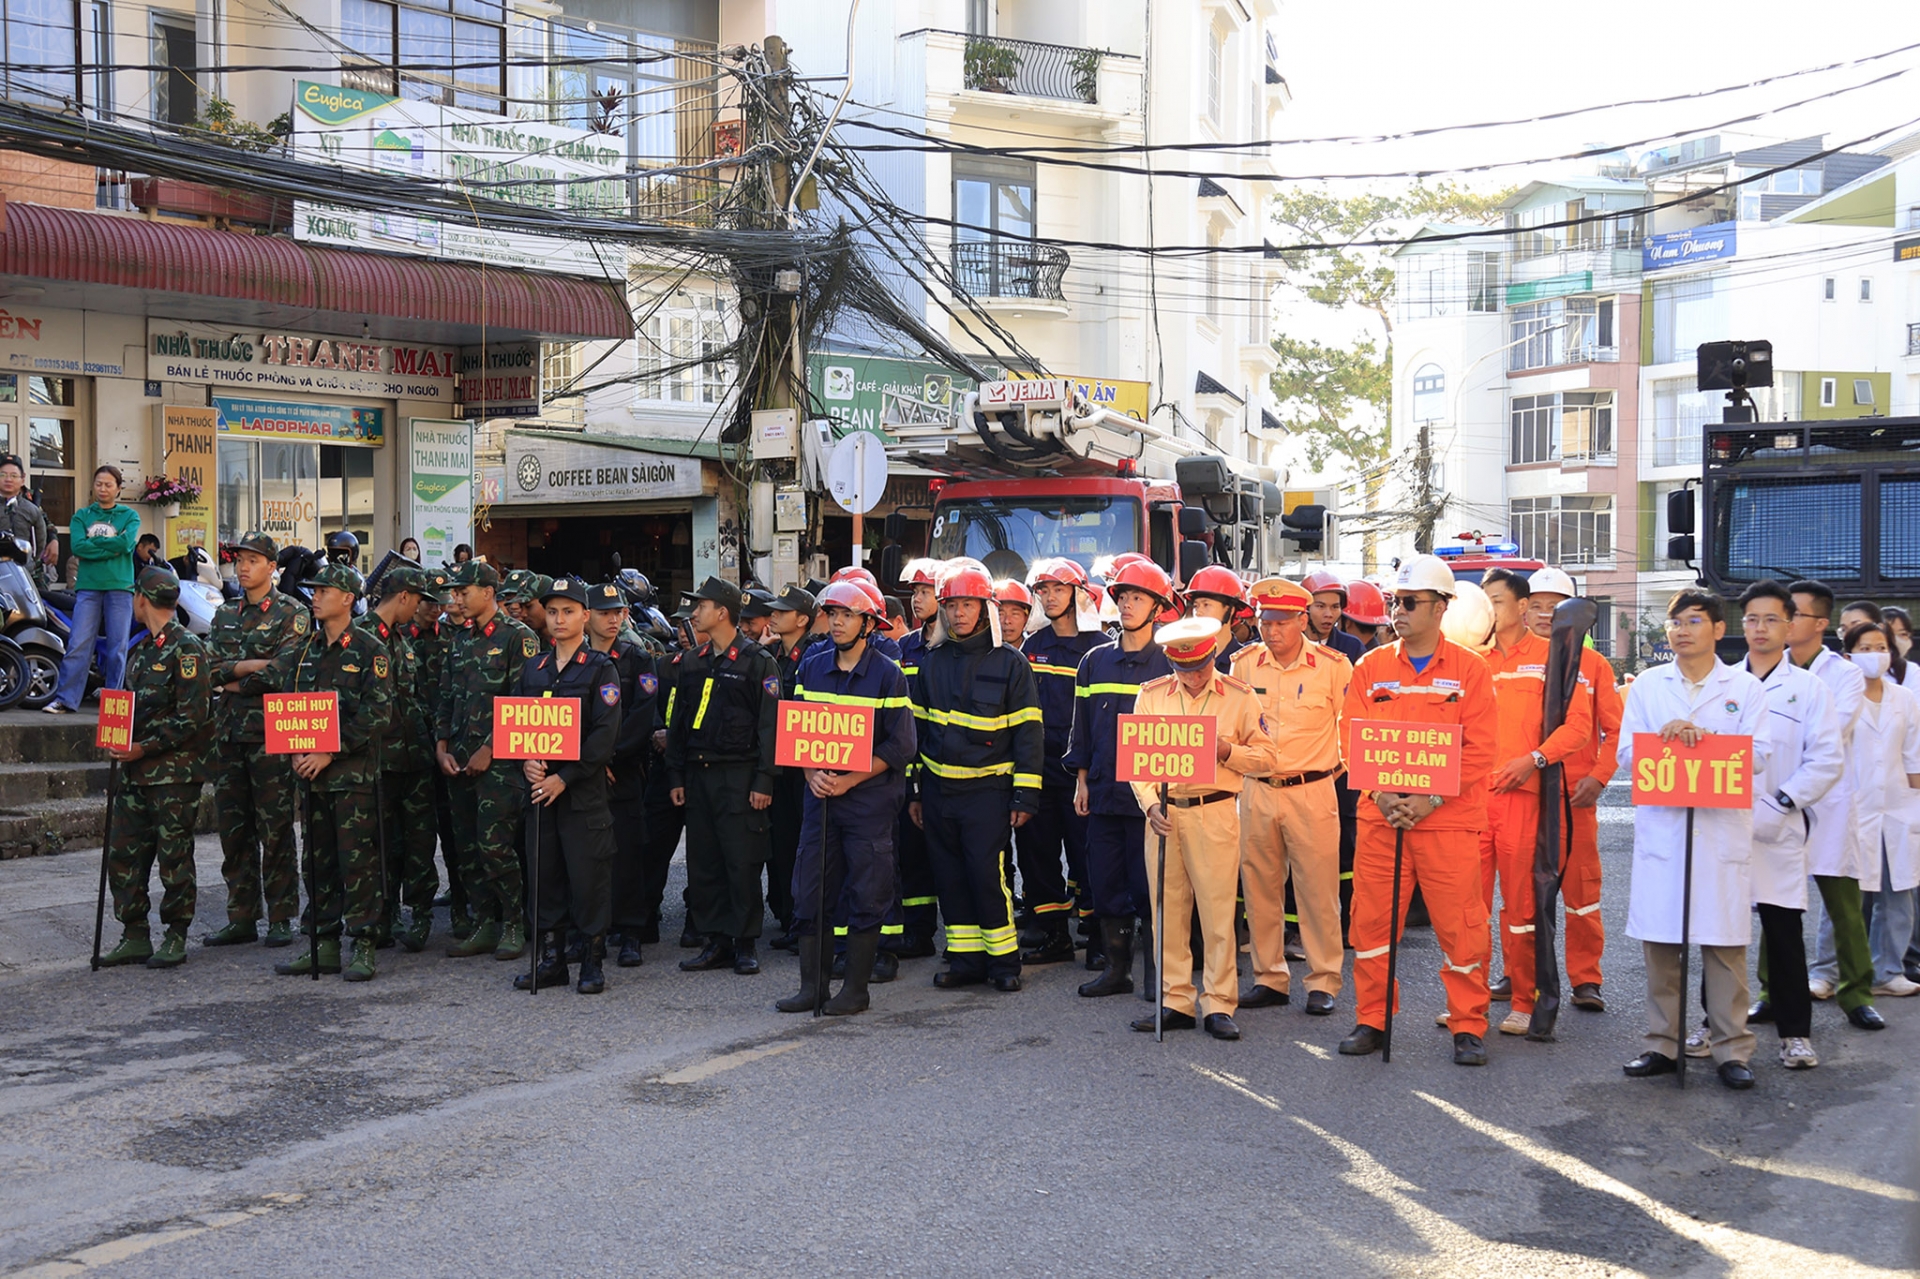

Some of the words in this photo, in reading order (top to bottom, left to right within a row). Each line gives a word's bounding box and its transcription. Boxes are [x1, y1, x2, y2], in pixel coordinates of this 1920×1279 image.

[304, 86, 363, 111] Eugica
[157, 332, 192, 358] NHÀ
[198, 333, 253, 362] THUỐC
[262, 335, 383, 373] THANH
[392, 347, 454, 378] MAI
[167, 364, 191, 377] BÁN
[213, 367, 253, 382] THUỐC
[407, 383, 439, 397] NGƯỜI
[856, 380, 877, 392] CAFÉ
[1008, 381, 1055, 400] VEMA
[168, 415, 184, 426] NHÀ
[186, 415, 212, 428] THUỐC
[241, 417, 333, 436] LADOPHAR
[168, 433, 213, 454] THANH
[416, 429, 435, 443] NHÀ
[437, 430, 468, 446] THUỐC
[415, 449, 449, 468] THANH
[450, 452, 469, 469] MAI
[179, 466, 203, 486] MAI
[549, 469, 592, 488] COFFEE
[596, 467, 628, 485] BEAN
[632, 460, 675, 484] SÀIGÒN
[415, 480, 446, 494] Eugica
[262, 491, 314, 523] THUỐC
[933, 515, 944, 539] 8
[267, 698, 284, 715] BỘ
[287, 696, 307, 712] CHỈ
[310, 699, 333, 711] HUY
[501, 699, 573, 727] PHÒNG
[275, 716, 308, 732] QUÂN
[311, 717, 329, 733] SỰ
[786, 705, 866, 737] PHÒNG
[288, 733, 316, 749] TỈNH
[509, 731, 564, 754] PK02
[1122, 717, 1204, 747] PHÒNG
[1361, 727, 1402, 742] C.TY
[1406, 728, 1453, 747] ĐIỆN
[794, 738, 854, 765] PC07
[1364, 749, 1400, 766] LỰC
[1405, 750, 1447, 767] LÂM
[1133, 752, 1194, 777] PC08
[1637, 747, 1676, 793] SỞ
[1684, 759, 1702, 793] Y
[1710, 749, 1747, 795] TẾ
